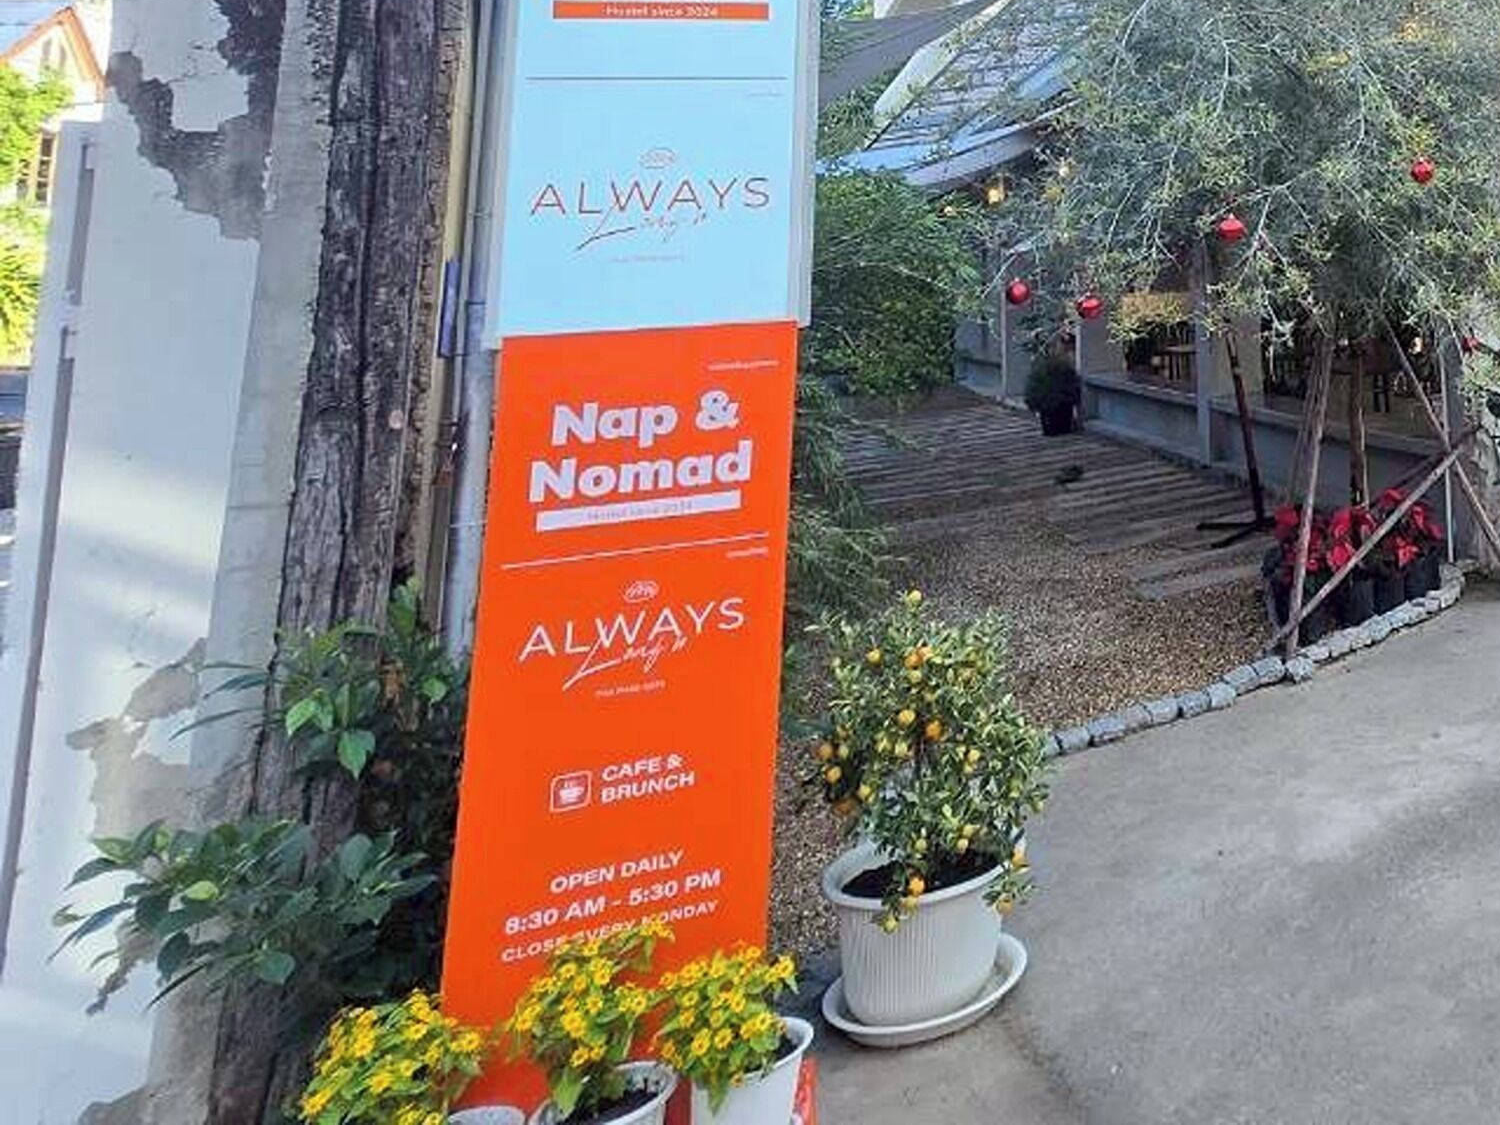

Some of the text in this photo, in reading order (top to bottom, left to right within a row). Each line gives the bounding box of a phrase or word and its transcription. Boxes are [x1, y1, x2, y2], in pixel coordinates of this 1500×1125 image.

[530, 176, 770, 216] ALWAYS
[551, 389, 740, 449] Nap &
[528, 437, 754, 503] Nomad
[518, 596, 746, 663] ALWAYS
[600, 770, 696, 804] BRUNCH
[601, 752, 684, 782] CAFE &
[550, 849, 685, 895] OPEN DAILY
[504, 907, 560, 935] 8:30
[564, 895, 607, 922] AM
[628, 880, 679, 907] 5:30
[684, 868, 722, 893] PM
